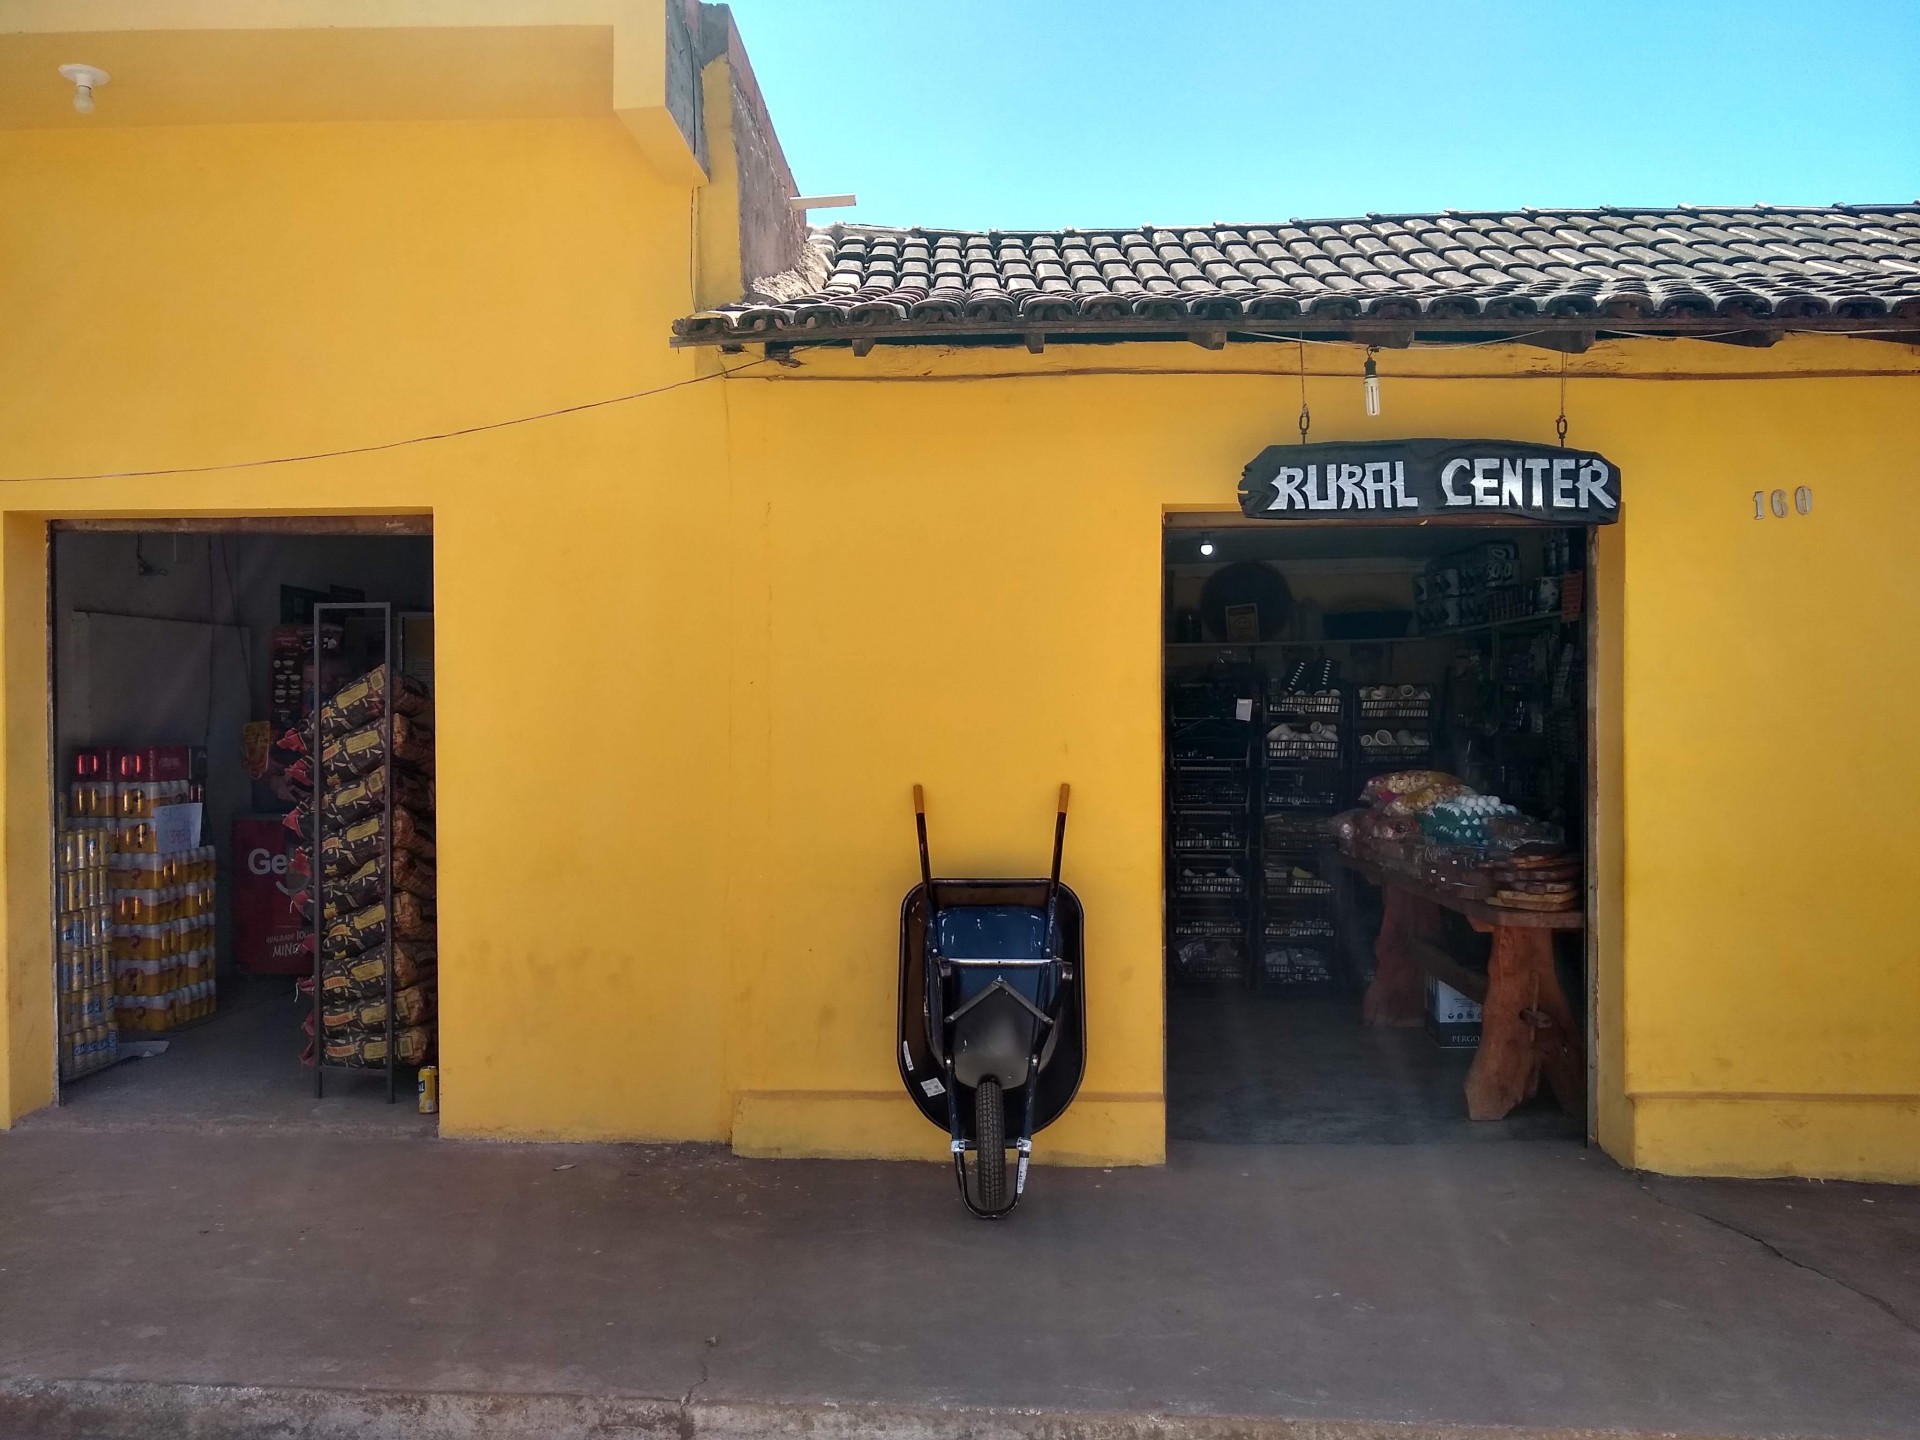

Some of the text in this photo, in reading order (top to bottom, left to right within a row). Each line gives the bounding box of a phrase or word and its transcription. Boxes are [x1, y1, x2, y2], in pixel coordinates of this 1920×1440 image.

[1267, 458, 1617, 511] RURAL CENTER
[1753, 486, 1812, 520] 160
